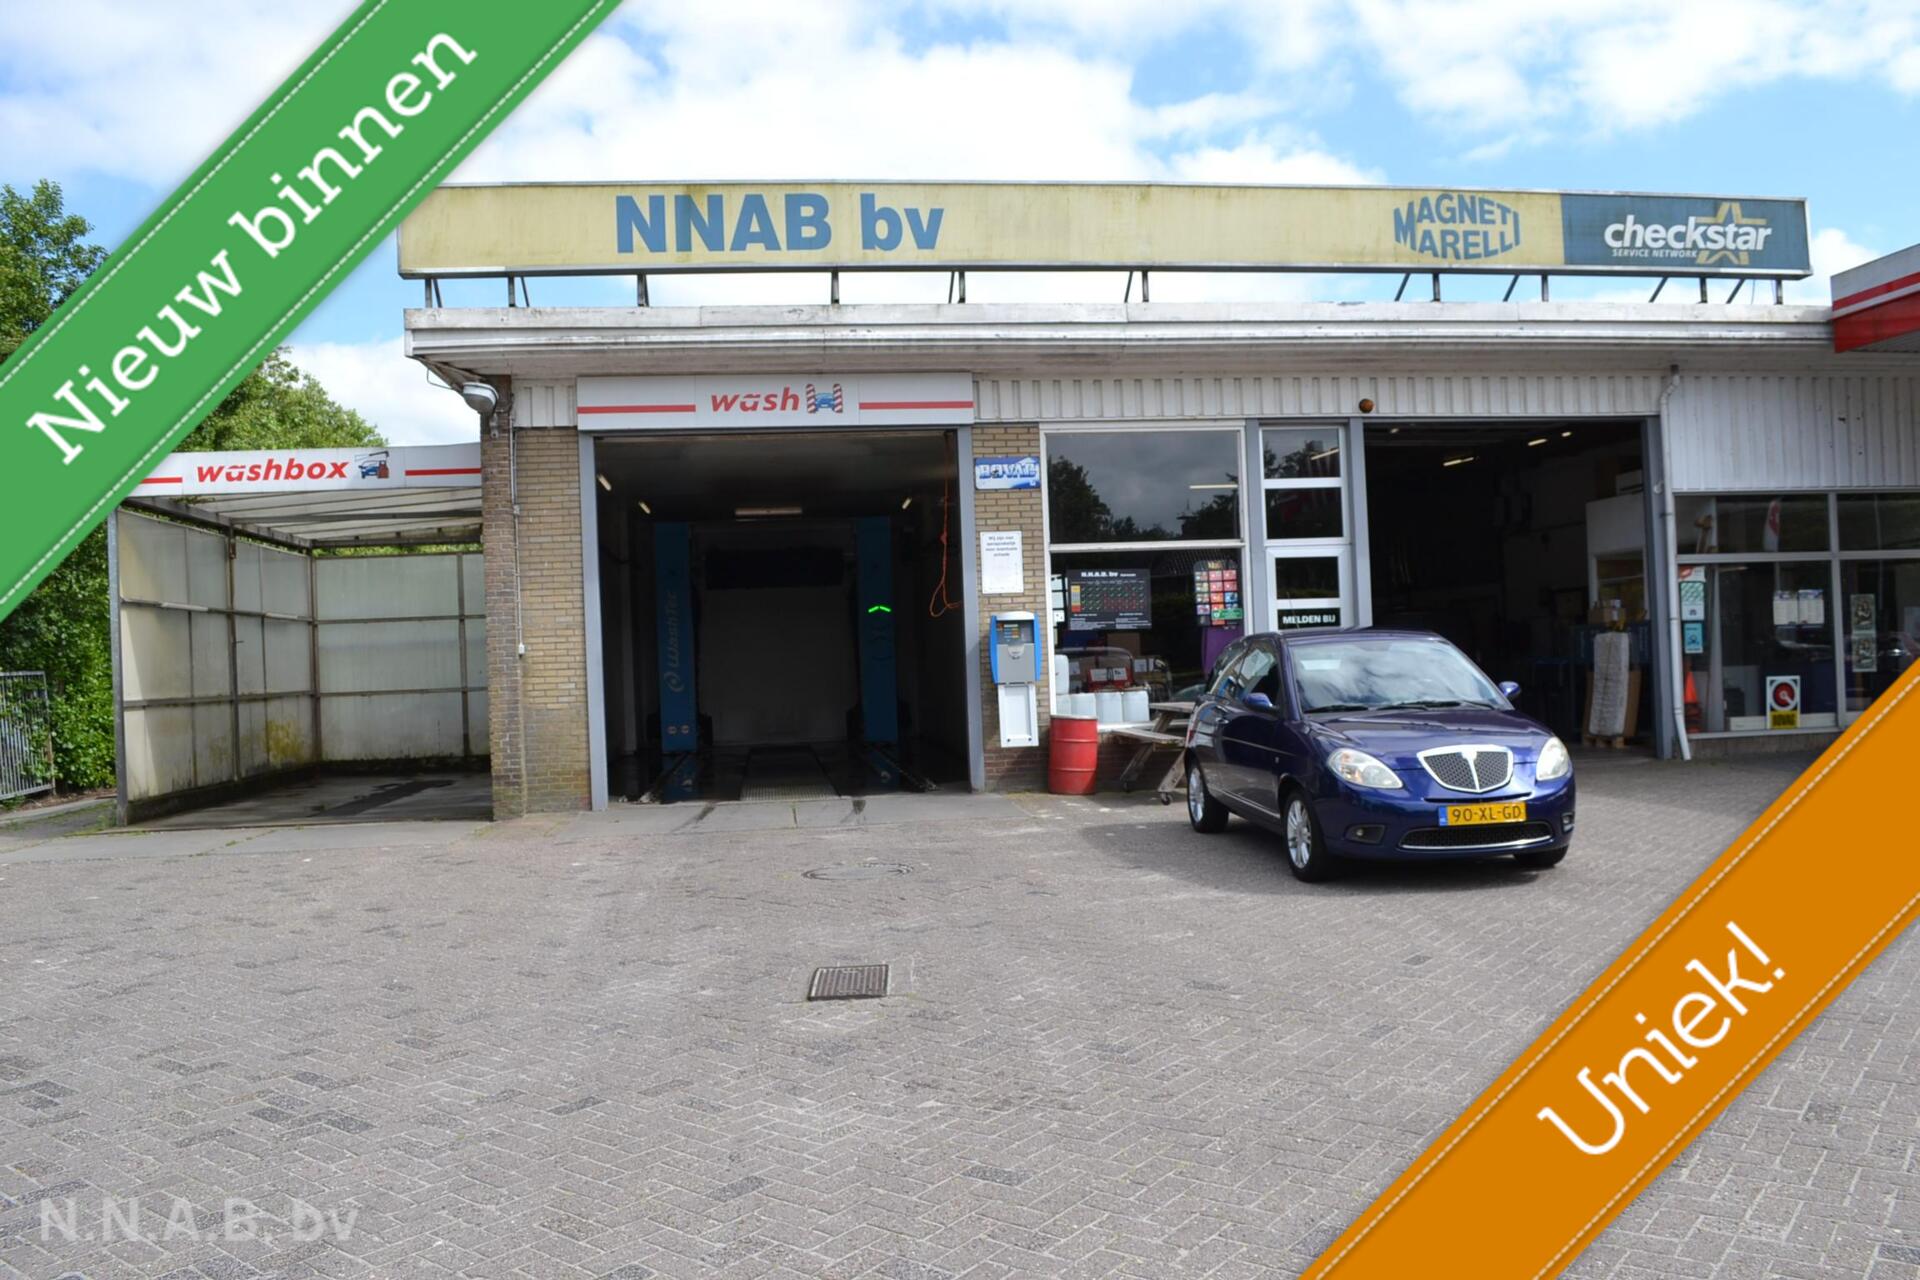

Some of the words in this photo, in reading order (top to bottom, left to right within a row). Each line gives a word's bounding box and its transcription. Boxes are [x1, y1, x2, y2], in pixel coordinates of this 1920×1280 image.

[615, 193, 833, 254] NNAB
[860, 193, 944, 252] bv
[1393, 193, 1520, 236] MAGNETI
[1393, 217, 1520, 260] MARELLI
[1604, 214, 1773, 251] checkstar
[1612, 248, 1649, 258] SERVICE
[1652, 249, 1698, 259] NETWORK
[711, 387, 799, 412] wash
[197, 458, 349, 483] washbox
[1282, 614, 1321, 624] MELDEN
[1452, 805, 1521, 822] 90-XL-GD
